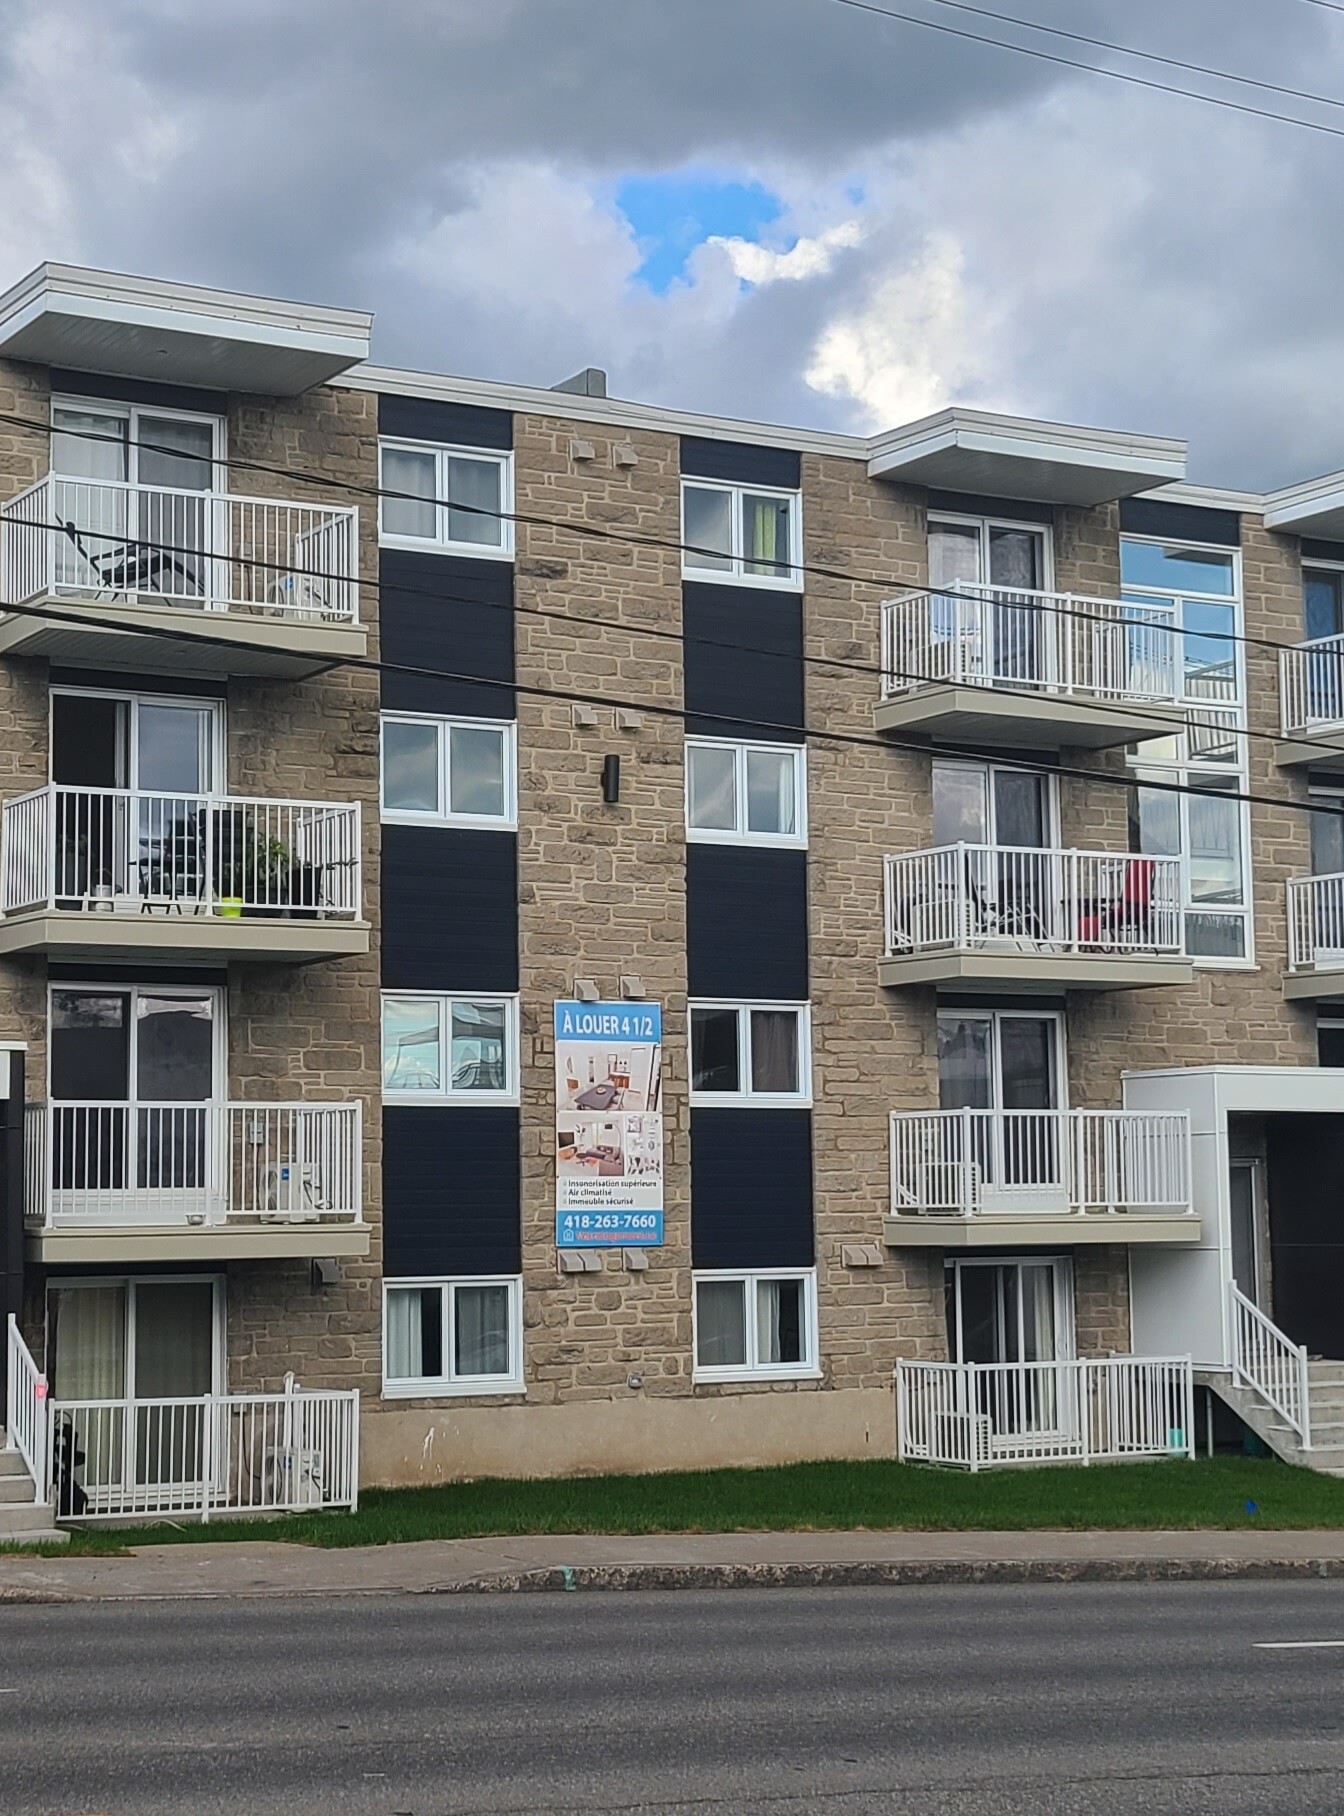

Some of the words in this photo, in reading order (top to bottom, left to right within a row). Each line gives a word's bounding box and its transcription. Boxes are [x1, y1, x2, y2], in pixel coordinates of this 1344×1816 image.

[562, 1010, 572, 1034] À
[576, 1015, 620, 1035] LOUER
[621, 1016, 630, 1035] 4
[632, 1016, 653, 1036] 1/2
[568, 1179, 619, 1187] Insonorisation
[620, 1179, 657, 1189] supérieure
[568, 1188, 579, 1196] Air
[580, 1188, 612, 1196] climatisé
[568, 1197, 605, 1205] Immeuble
[606, 1197, 634, 1205] sécurisé
[563, 1214, 656, 1228] 418-263-7660
